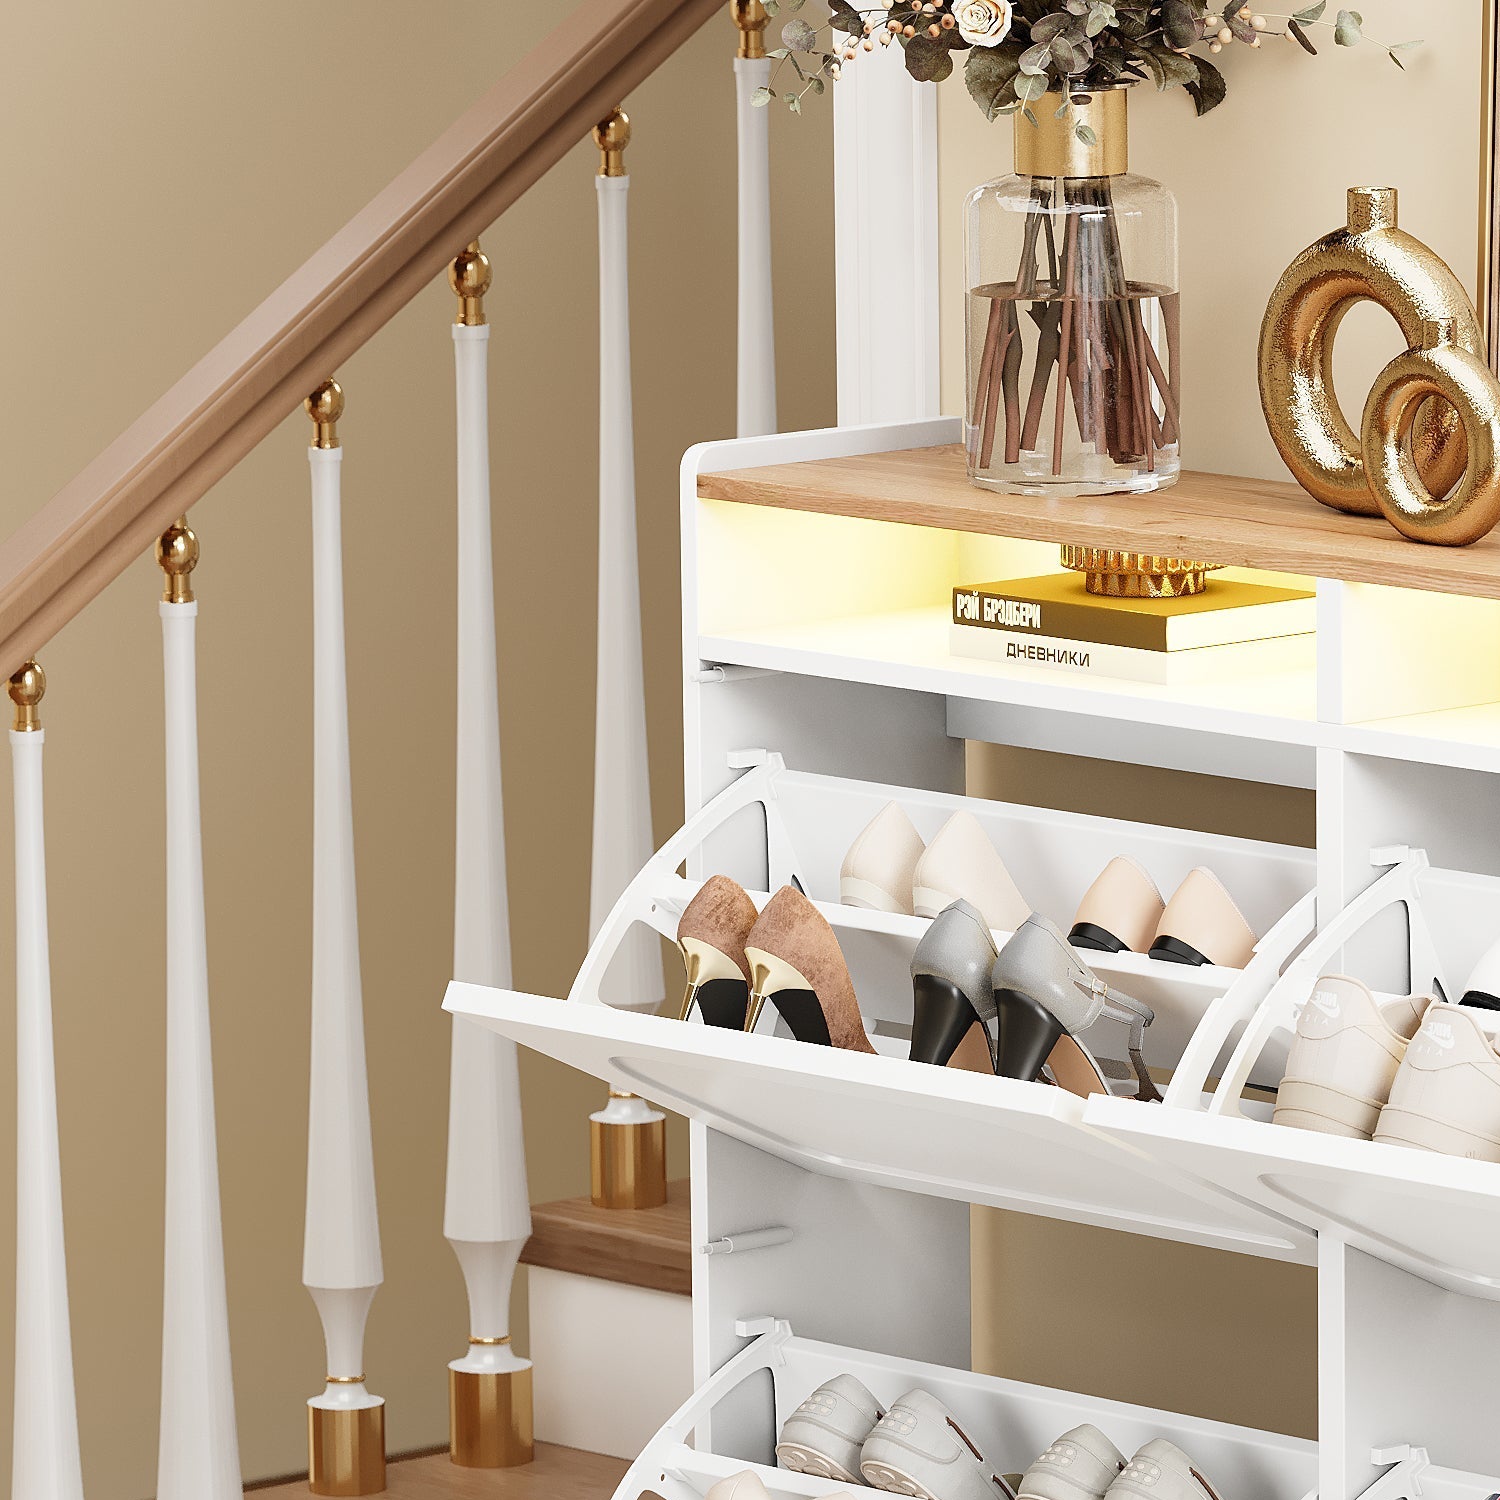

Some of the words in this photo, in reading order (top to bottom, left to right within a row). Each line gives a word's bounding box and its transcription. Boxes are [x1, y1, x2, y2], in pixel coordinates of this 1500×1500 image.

[956, 591, 980, 621] РЭЙ
[983, 597, 1041, 629] БРЭДБЕРИ
[1006, 642, 1090, 667] ДНЕВНИКИ
